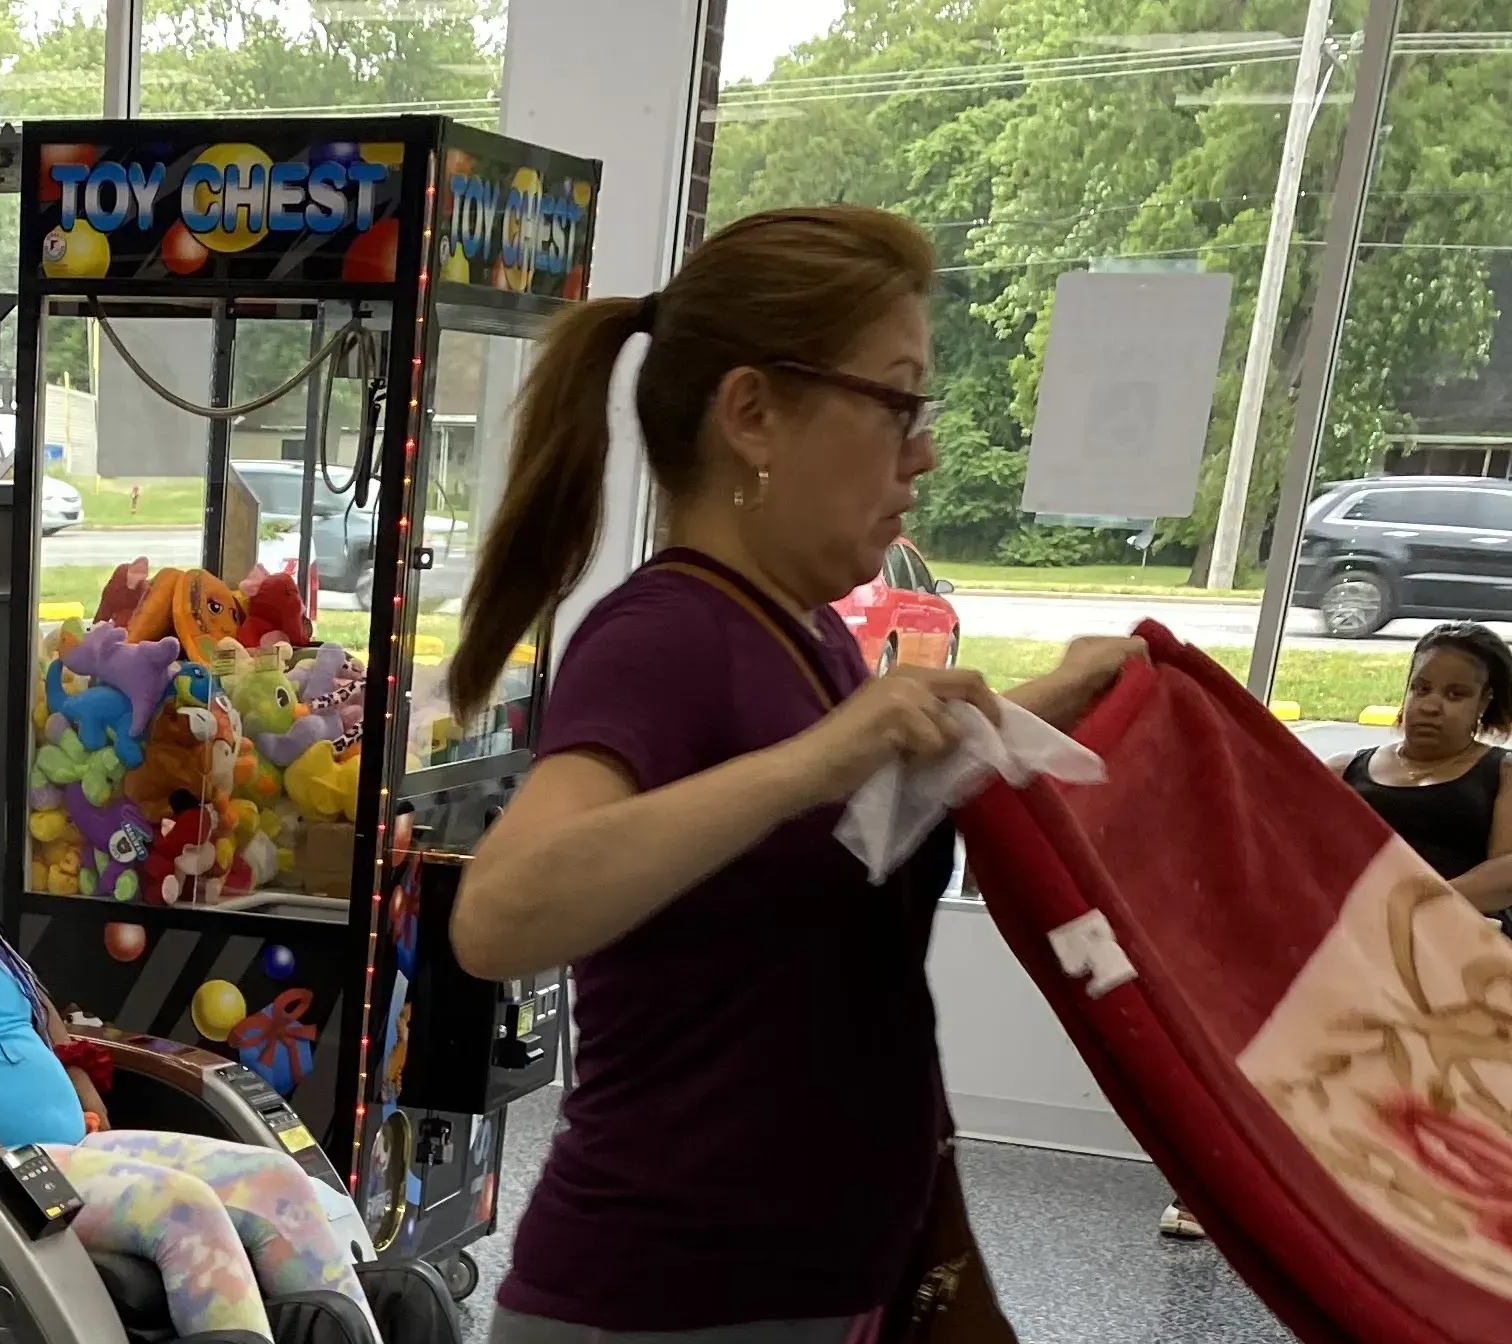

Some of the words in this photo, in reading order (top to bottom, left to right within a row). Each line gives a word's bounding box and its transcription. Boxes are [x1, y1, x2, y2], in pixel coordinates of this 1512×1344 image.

[51, 160, 166, 233] TOY
[180, 161, 389, 234] CHEST
[450, 173, 501, 263] TOY
[502, 186, 582, 275] CHEST
